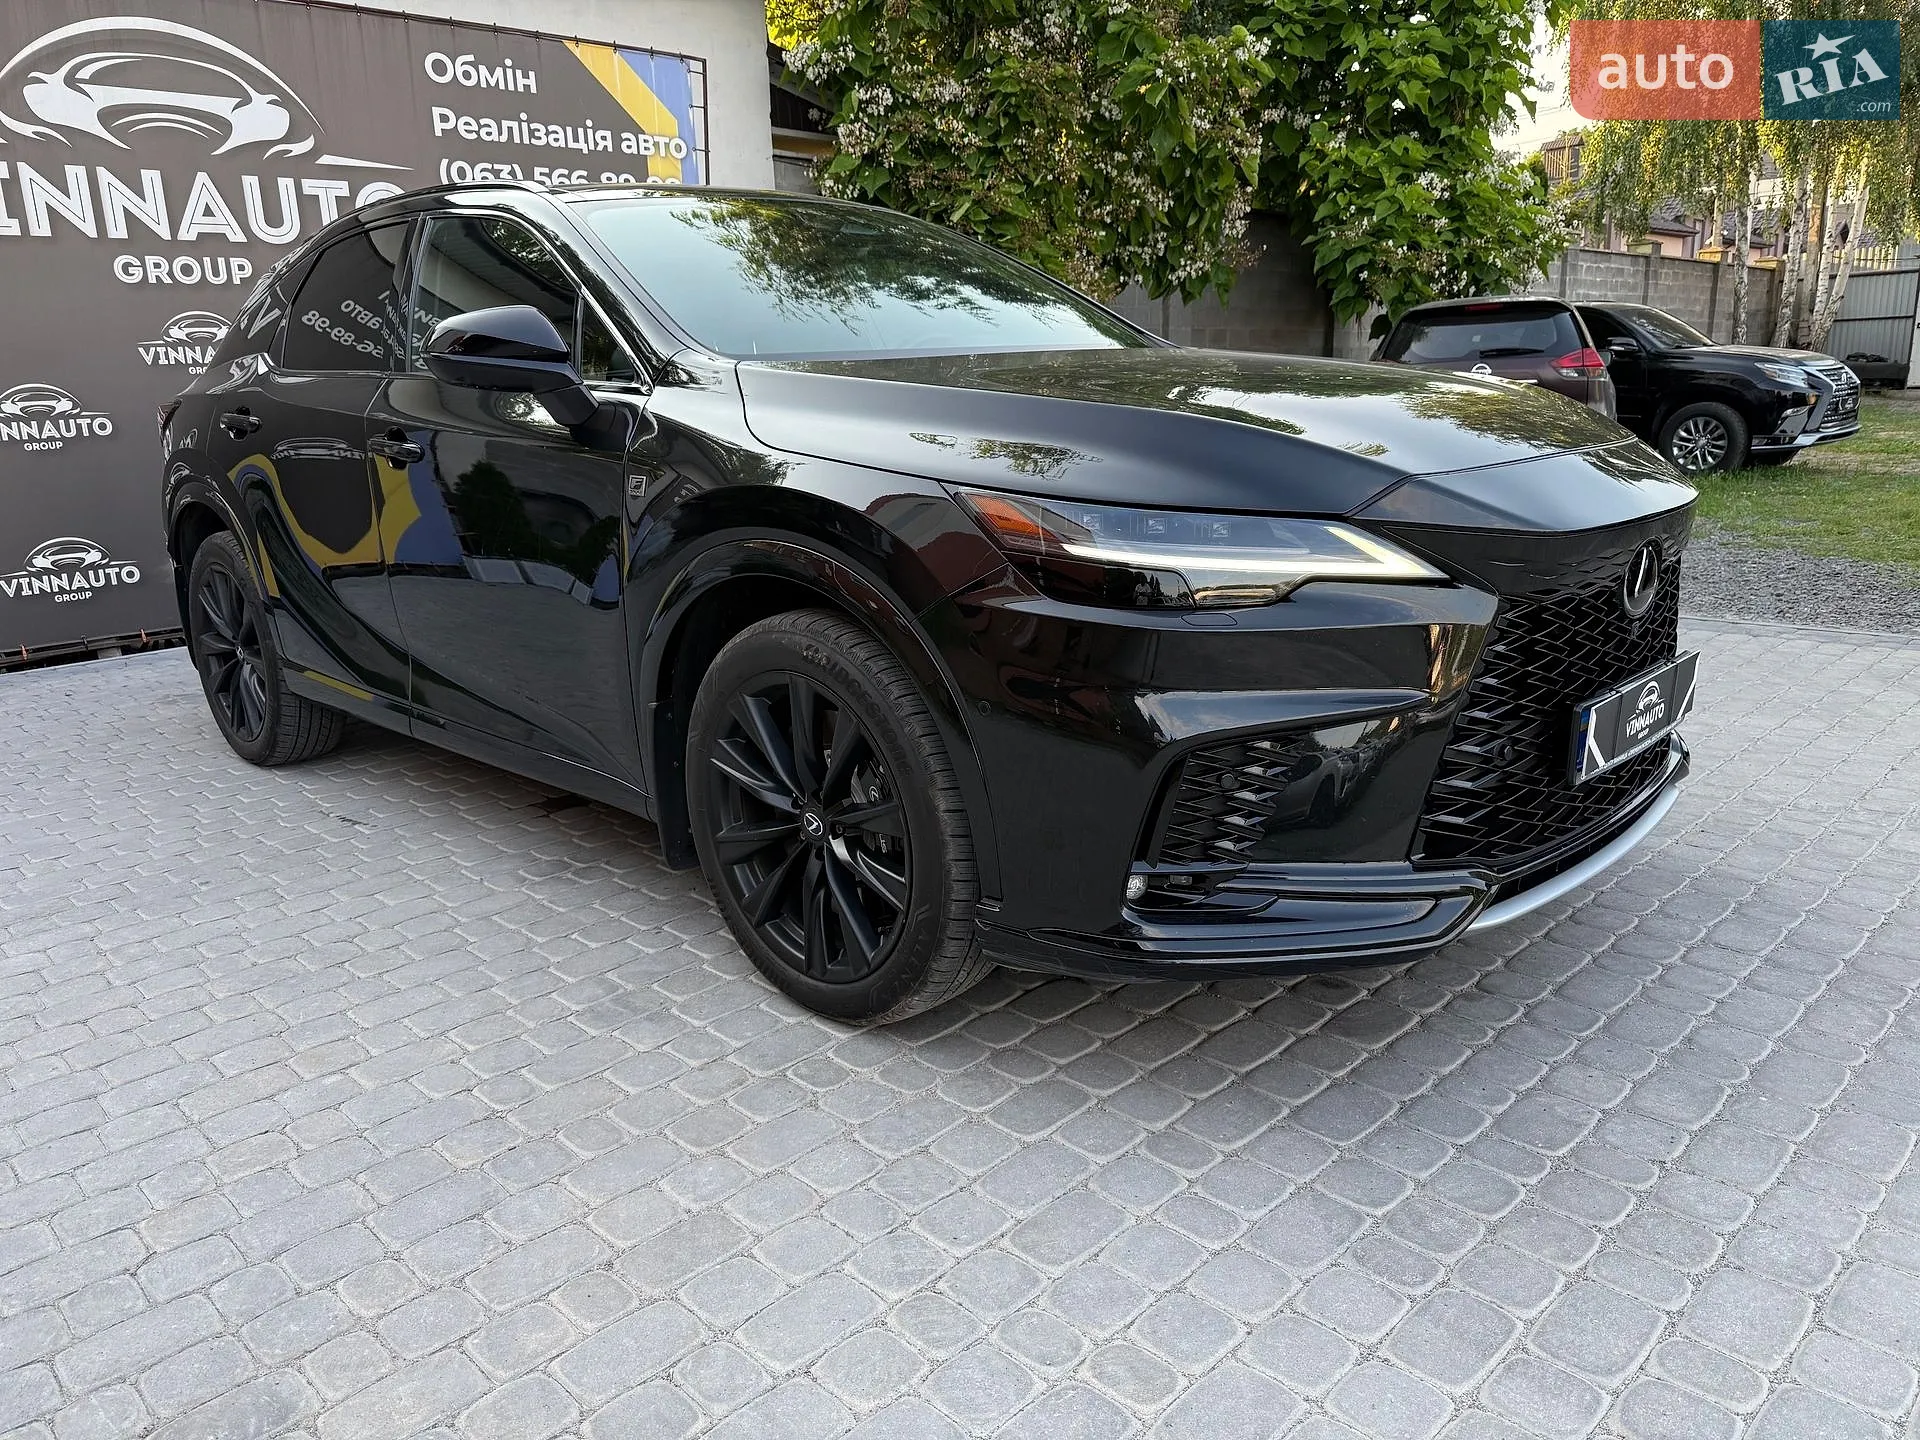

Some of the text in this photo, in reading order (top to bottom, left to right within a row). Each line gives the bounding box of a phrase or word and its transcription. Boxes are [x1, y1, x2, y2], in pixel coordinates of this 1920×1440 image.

[424, 52, 537, 94] Обмін
[431, 107, 688, 159] Реалізація авто
[113, 254, 253, 285] GROUP
[24, 441, 63, 451] GROUP
[0, 566, 141, 598] VINNAUTO
[54, 590, 93, 603] GROUP
[1626, 702, 1665, 739] VINNAUTO
